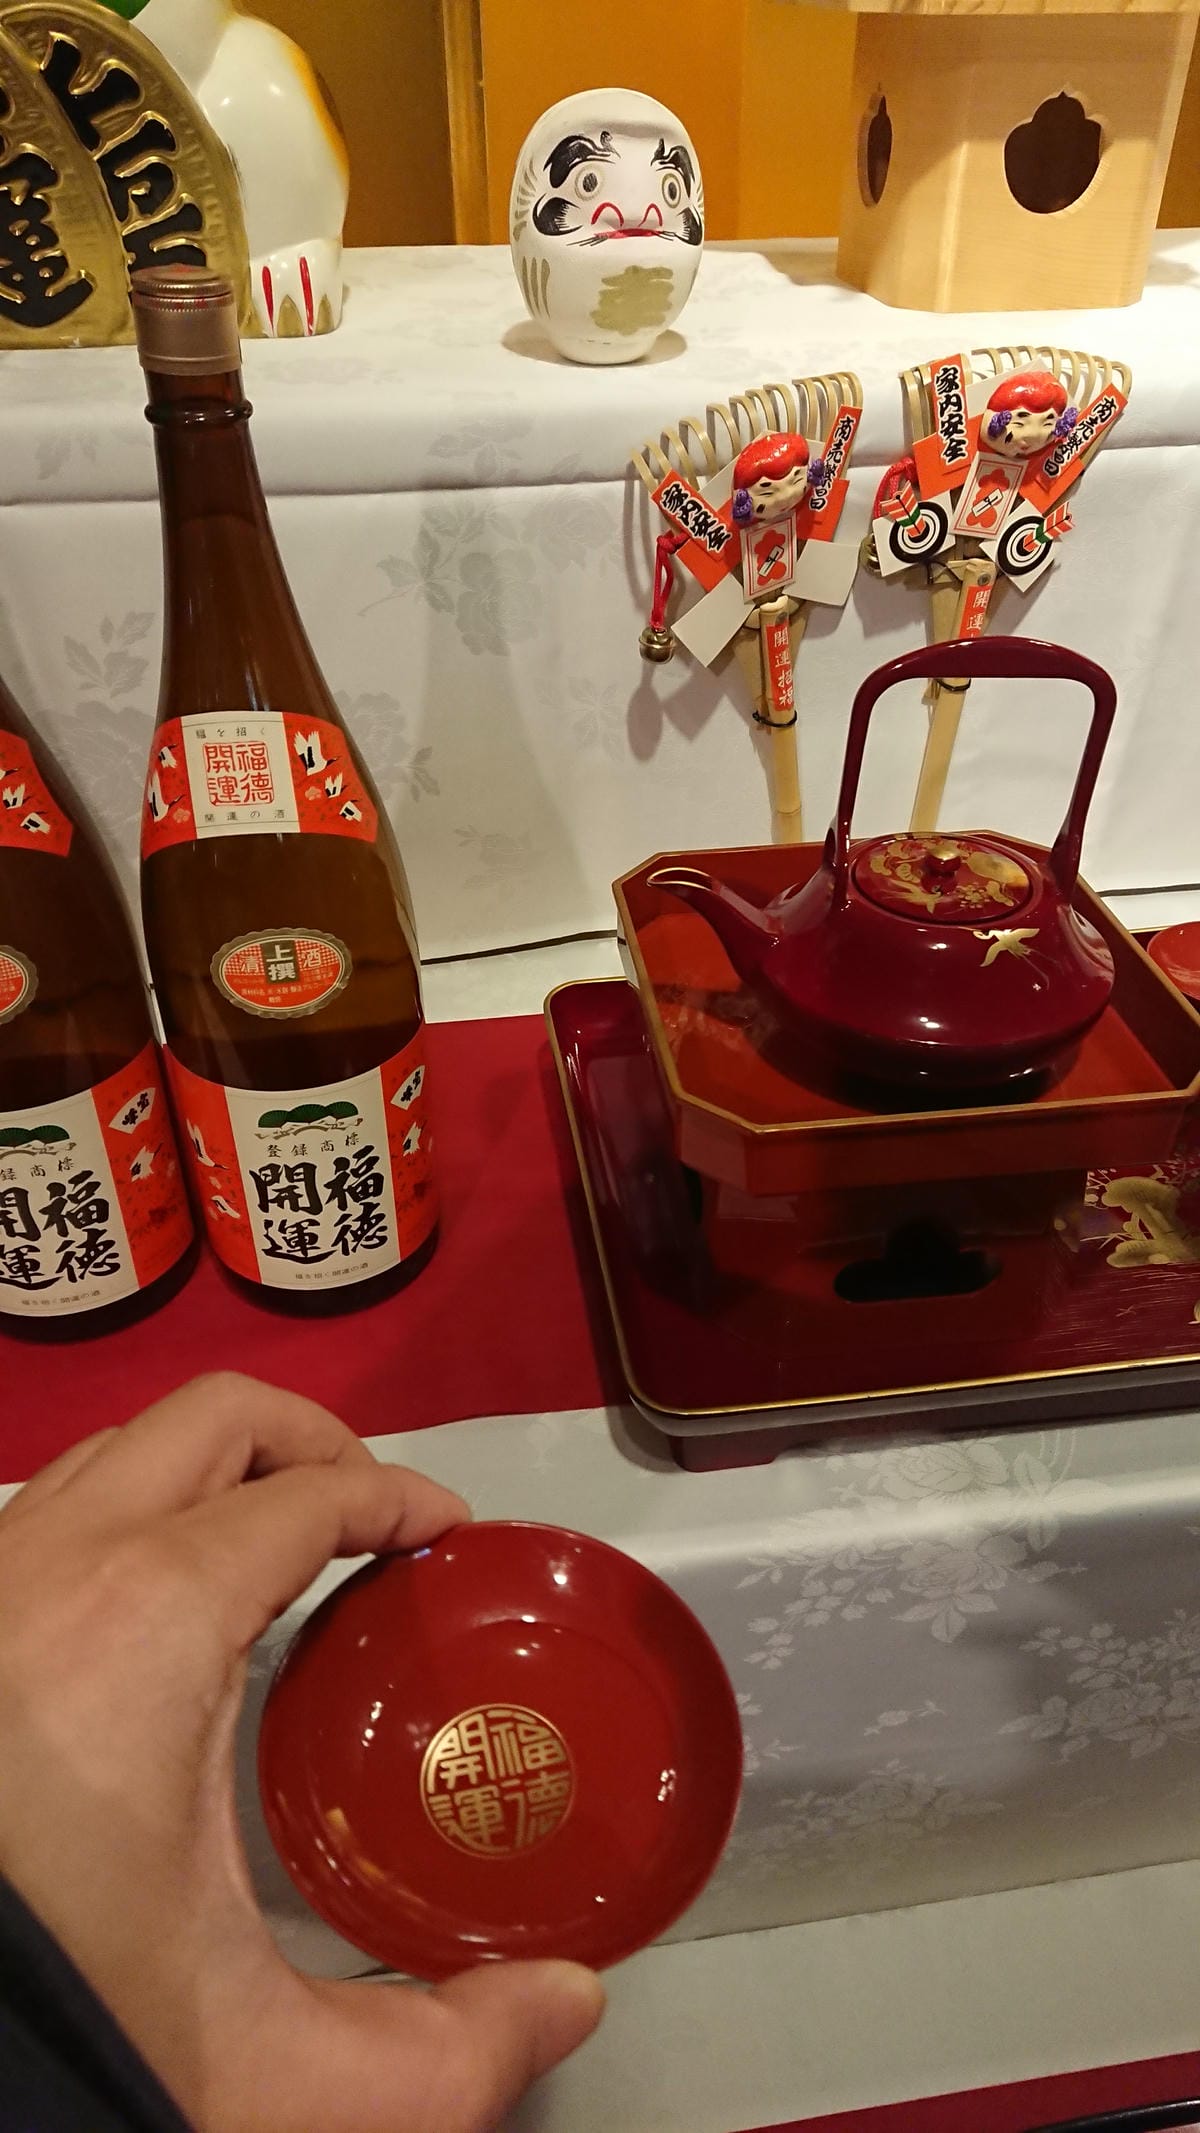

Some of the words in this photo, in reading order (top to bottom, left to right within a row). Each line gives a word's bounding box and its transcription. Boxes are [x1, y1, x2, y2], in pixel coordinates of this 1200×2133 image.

[935, 366, 968, 465] 家内安全
[660, 482, 733, 552] 家内安全
[966, 589, 992, 638] 開運
[774, 626, 794, 706] 開運招福
[266, 1133, 361, 1158] 登録商標
